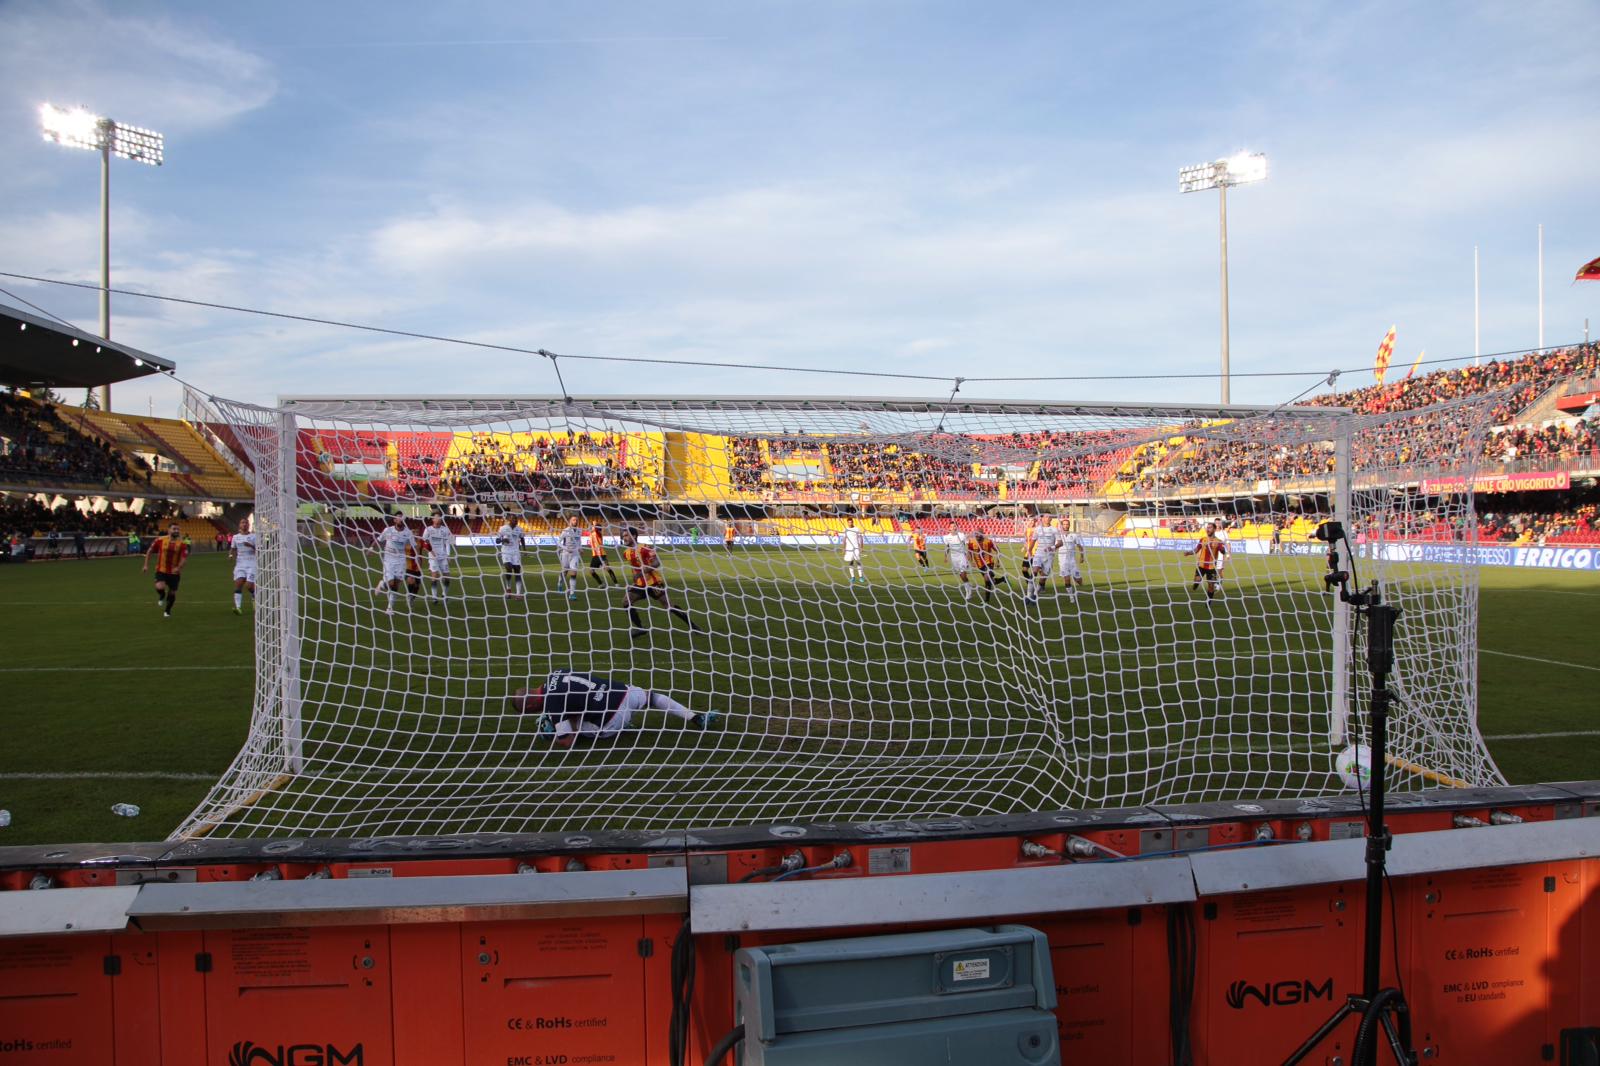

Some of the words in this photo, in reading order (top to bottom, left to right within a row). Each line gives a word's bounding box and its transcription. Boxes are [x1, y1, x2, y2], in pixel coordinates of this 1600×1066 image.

[1496, 480, 1514, 490] CIRO
[1516, 477, 1555, 489] VIGORITO
[1514, 547, 1592, 570] ERRICO
[1466, 947, 1493, 959] RoHs
[1494, 946, 1520, 957] certified
[1226, 976, 1333, 1009] NGM
[1443, 983, 1462, 993] EMC
[1471, 981, 1489, 991] LVD
[1491, 979, 1525, 990] compliance
[1464, 993, 1477, 1003] EU
[1477, 991, 1506, 1002] standards
[535, 1016, 572, 1029] RoHs
[574, 1017, 608, 1028] certified
[36, 1038, 73, 1049] certified
[507, 1056, 533, 1066] EMC
[545, 1054, 568, 1065] LVD
[571, 1053, 616, 1065] compliance
